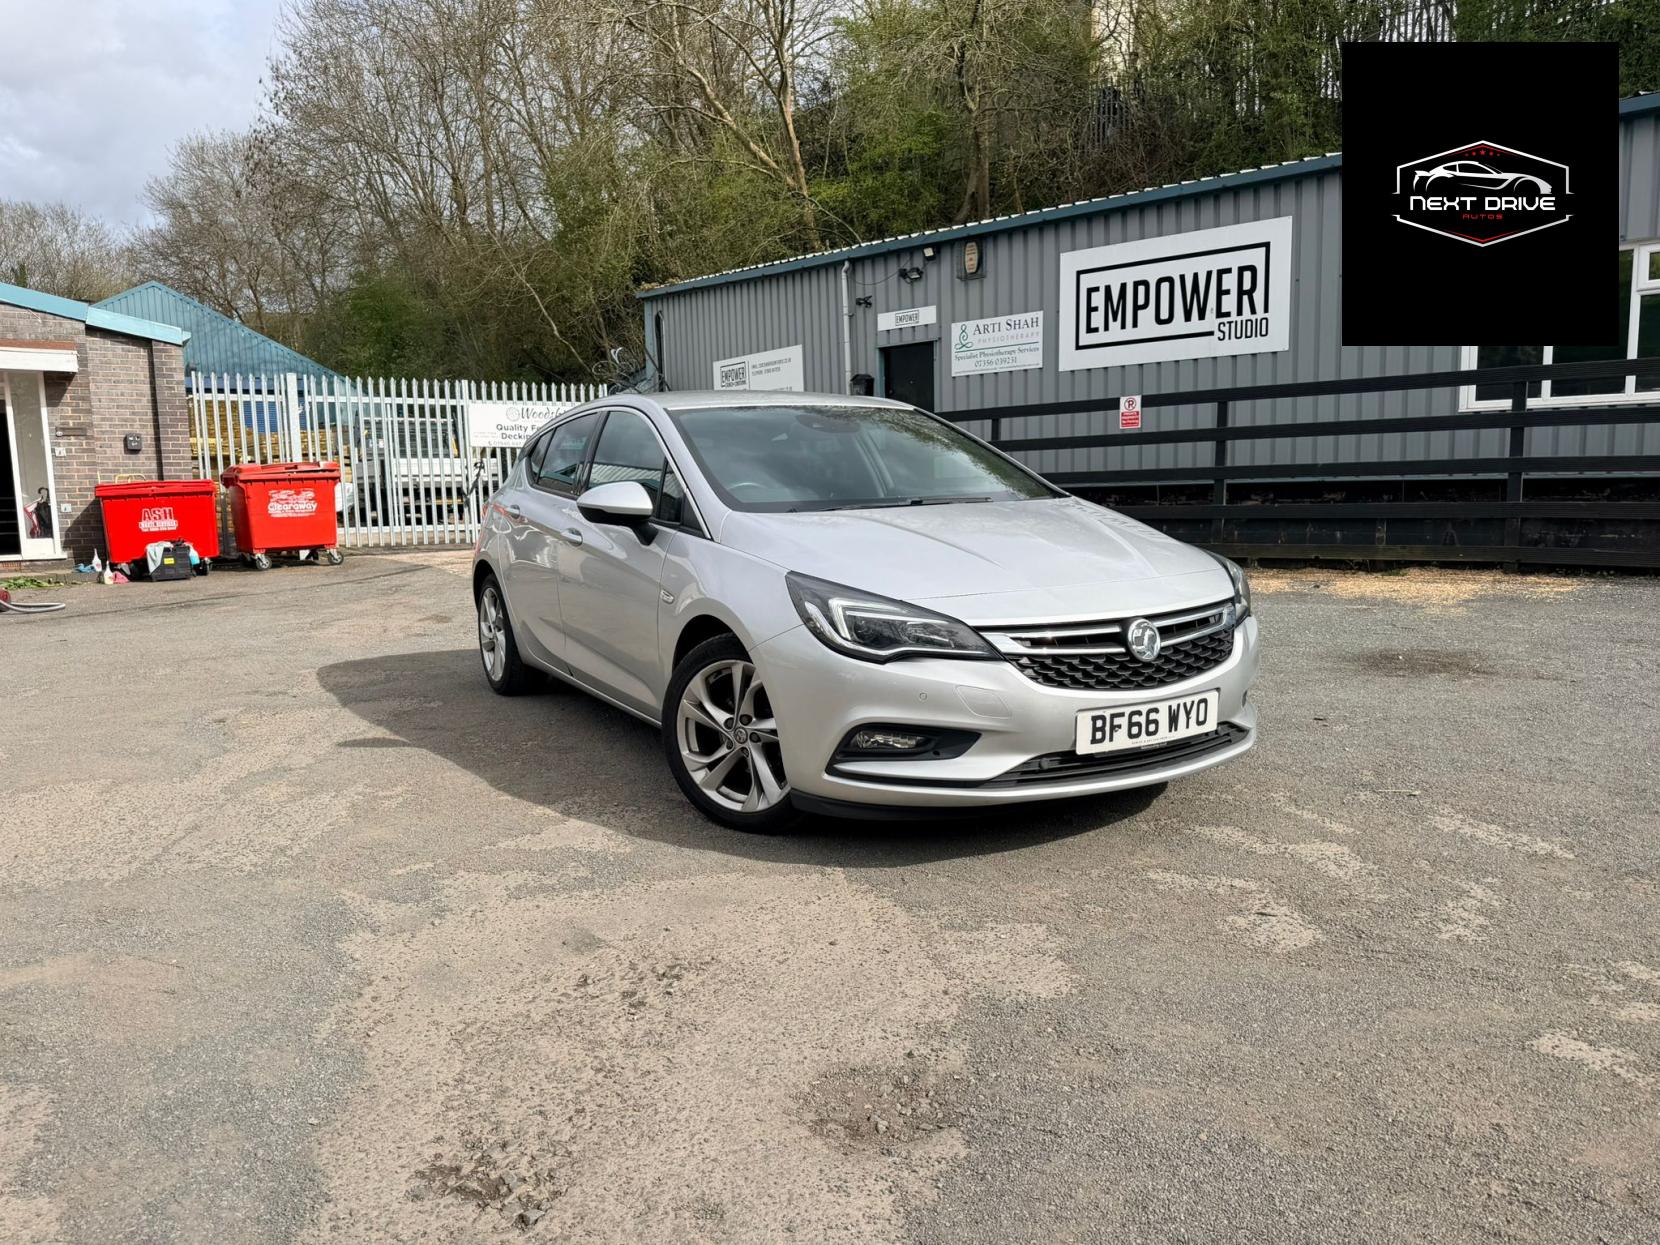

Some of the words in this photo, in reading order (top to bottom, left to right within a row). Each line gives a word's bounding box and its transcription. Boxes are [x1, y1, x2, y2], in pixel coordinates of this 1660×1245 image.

[1086, 264, 1257, 334] EMPOWER
[895, 312, 918, 324] EMPOWER
[973, 322, 1001, 335] ARTI
[1005, 317, 1039, 331] SHAH
[1218, 317, 1268, 341] STUDIO
[978, 331, 1040, 343] PHYSIOTHERAPY
[980, 349, 1016, 359] Physiotherapy
[1017, 346, 1040, 354] Services
[721, 366, 745, 384] EMPOWER
[496, 423, 528, 433] Quality
[267, 501, 317, 512] Clearaway
[142, 507, 173, 521] ASH
[1090, 707, 1160, 745] BF66
[1168, 698, 1208, 733] WYO
